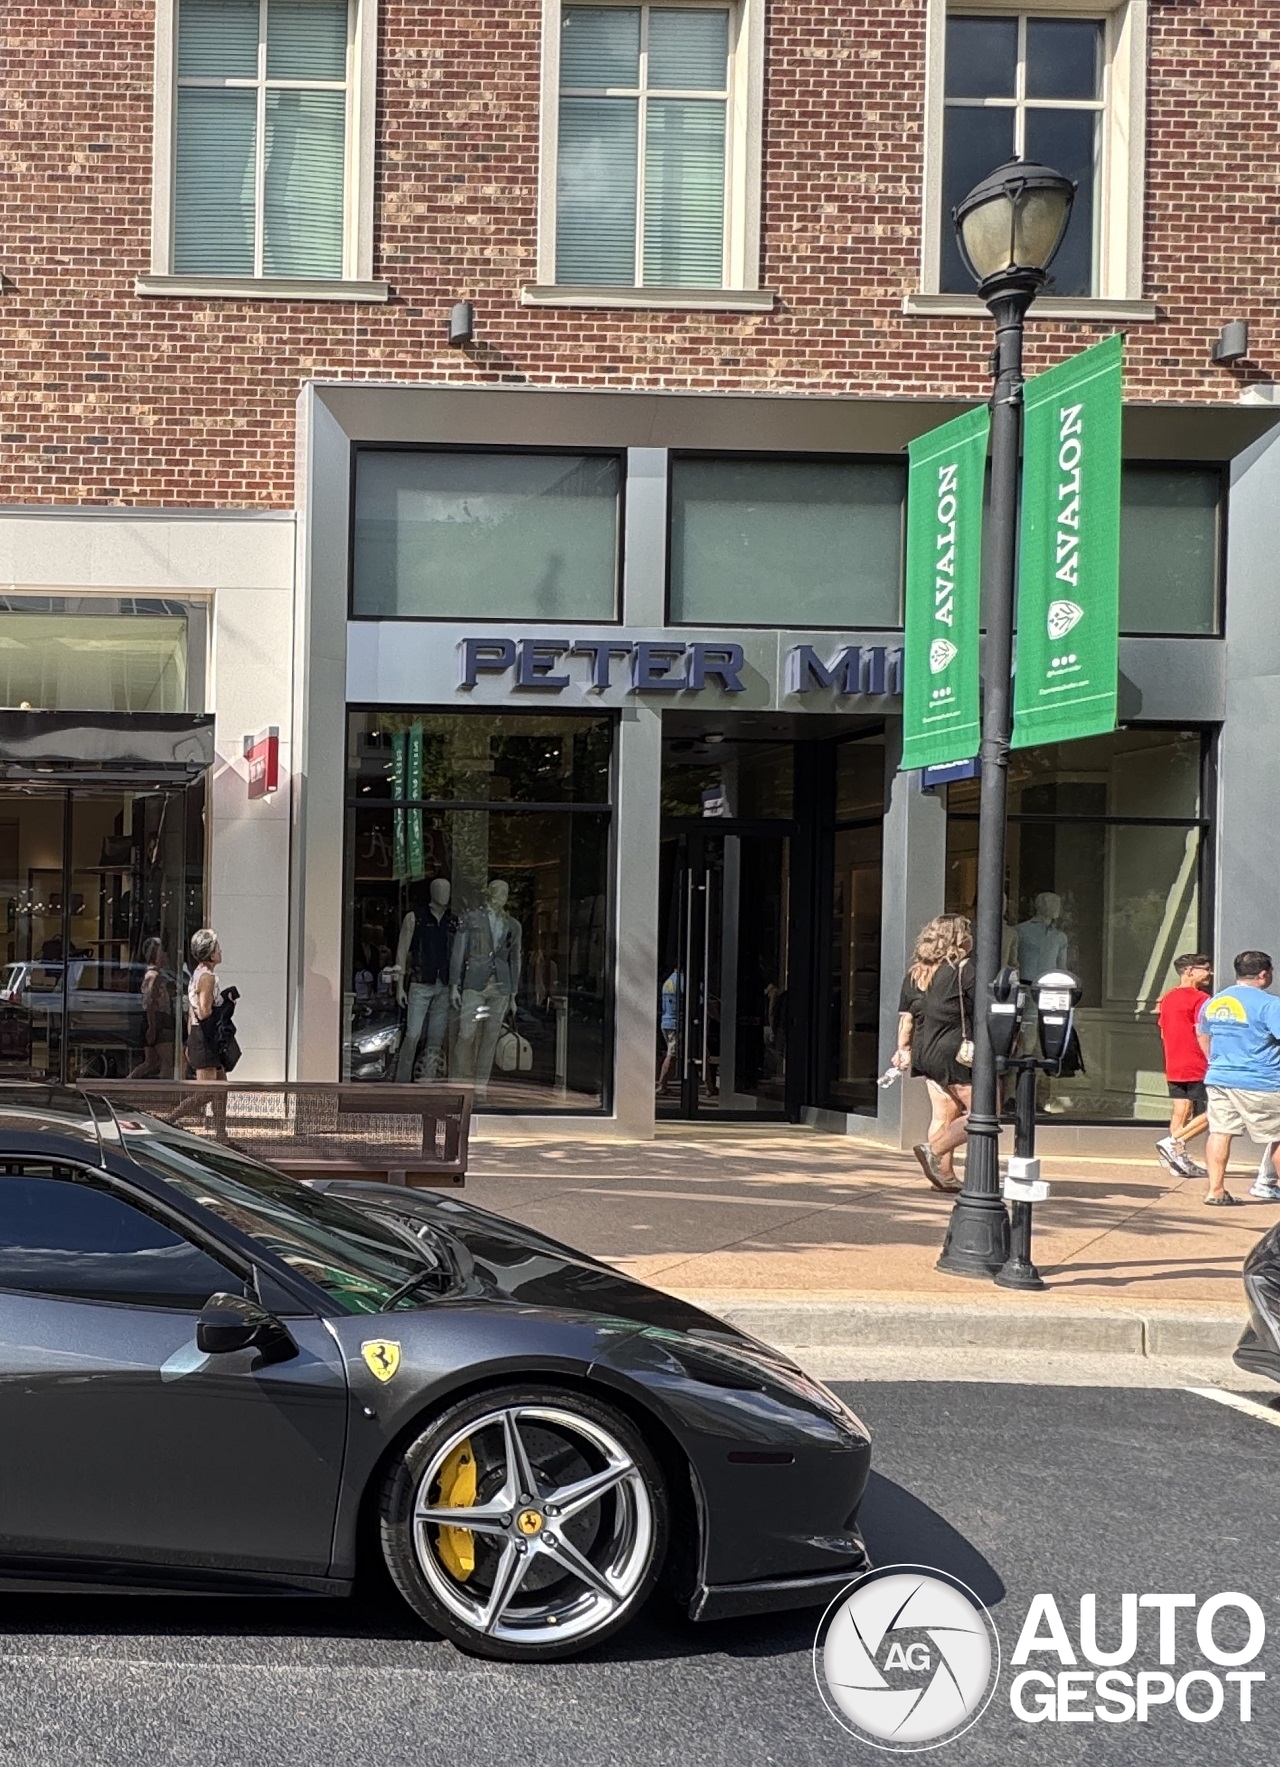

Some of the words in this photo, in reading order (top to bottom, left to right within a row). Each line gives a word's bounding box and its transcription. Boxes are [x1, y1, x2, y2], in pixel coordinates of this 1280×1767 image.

[935, 463, 959, 628] AVALON
[1055, 403, 1083, 587] AVALON
[458, 637, 748, 692] PETER
[786, 644, 905, 696] MI
